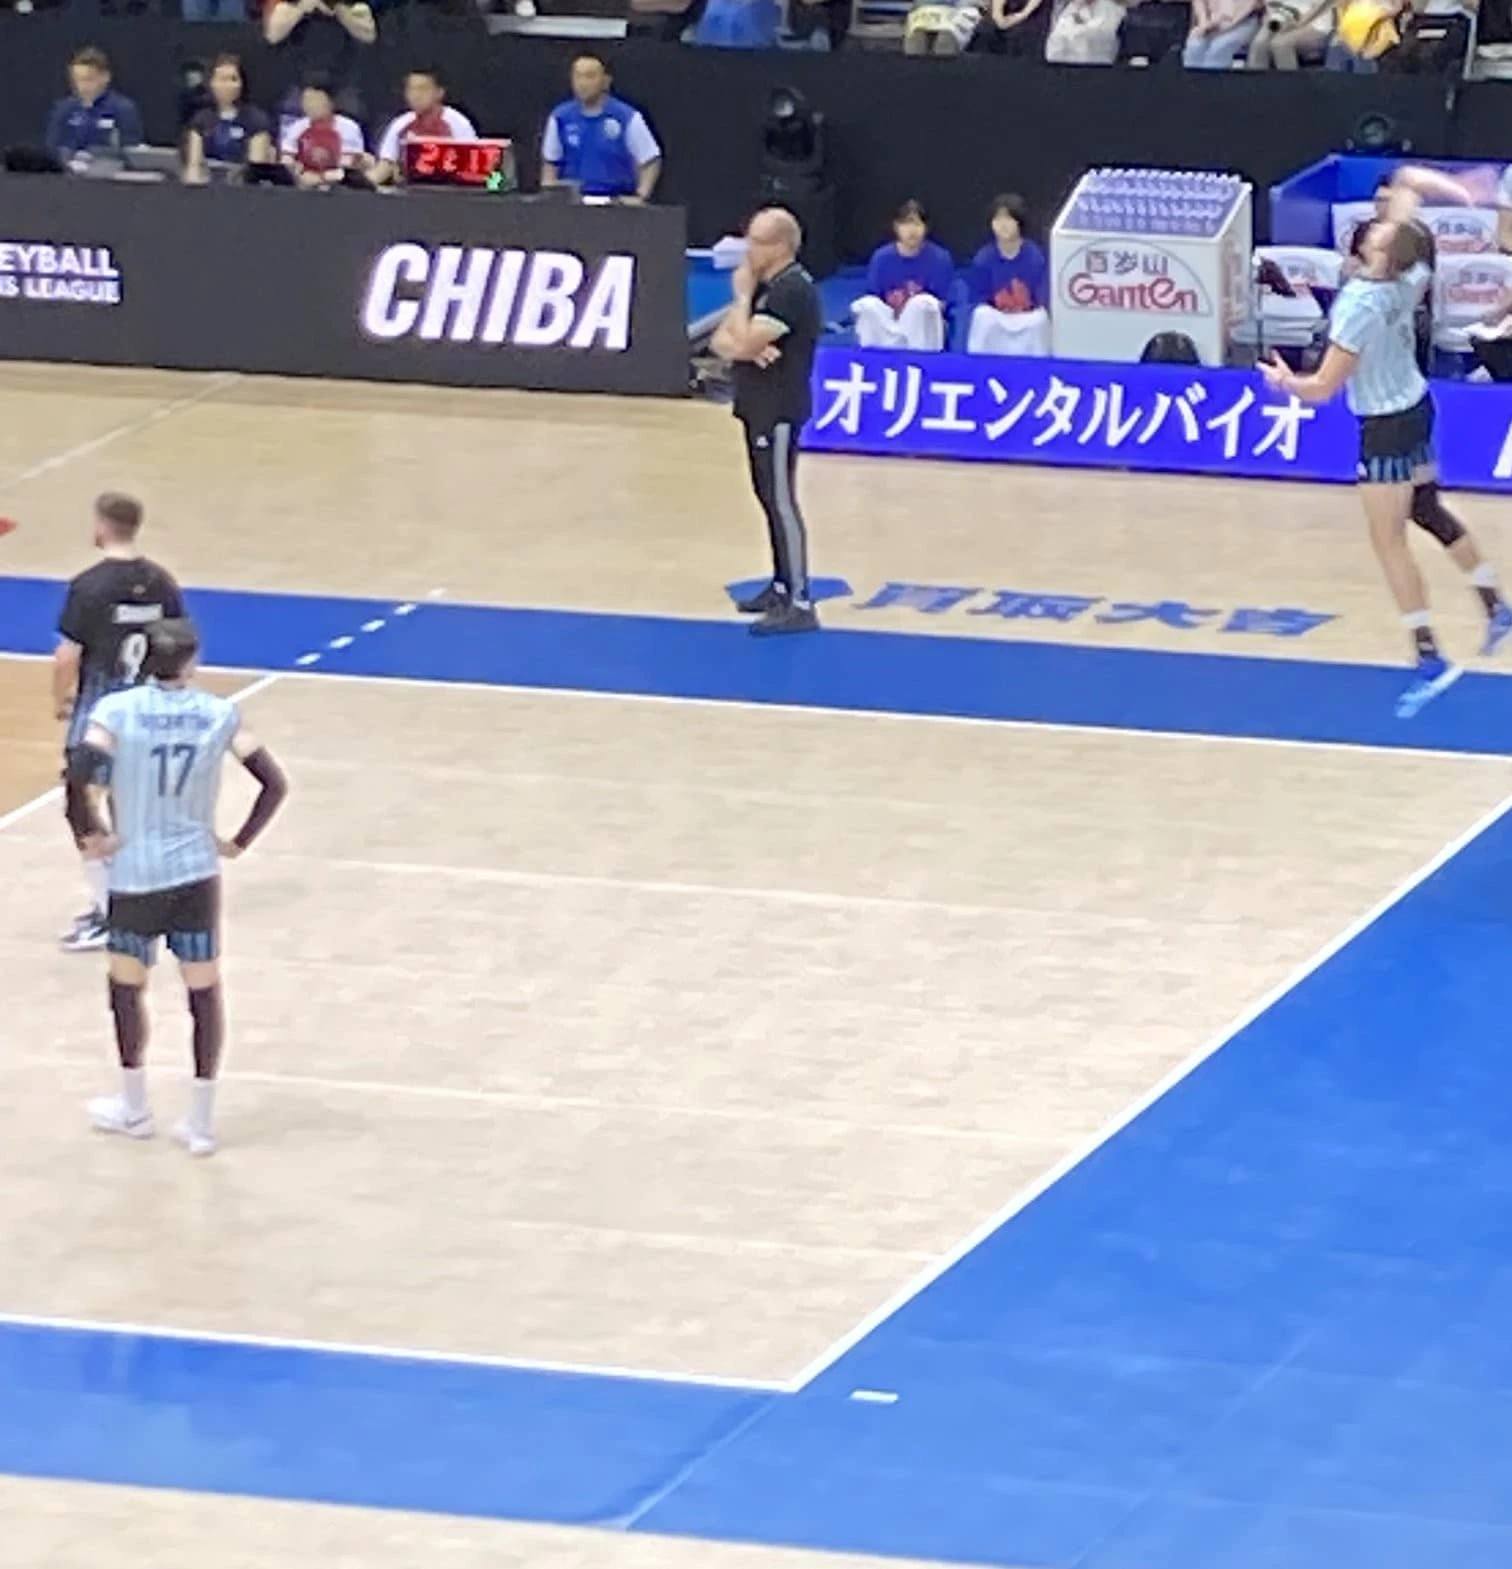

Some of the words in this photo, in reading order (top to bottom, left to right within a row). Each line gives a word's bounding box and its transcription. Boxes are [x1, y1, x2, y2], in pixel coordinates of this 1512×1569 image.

[22, 277, 120, 304] LEAGUE
[363, 242, 635, 350] CHIBA
[814, 362, 1317, 462] オリエンタルバイオ
[151, 743, 197, 798] 17
